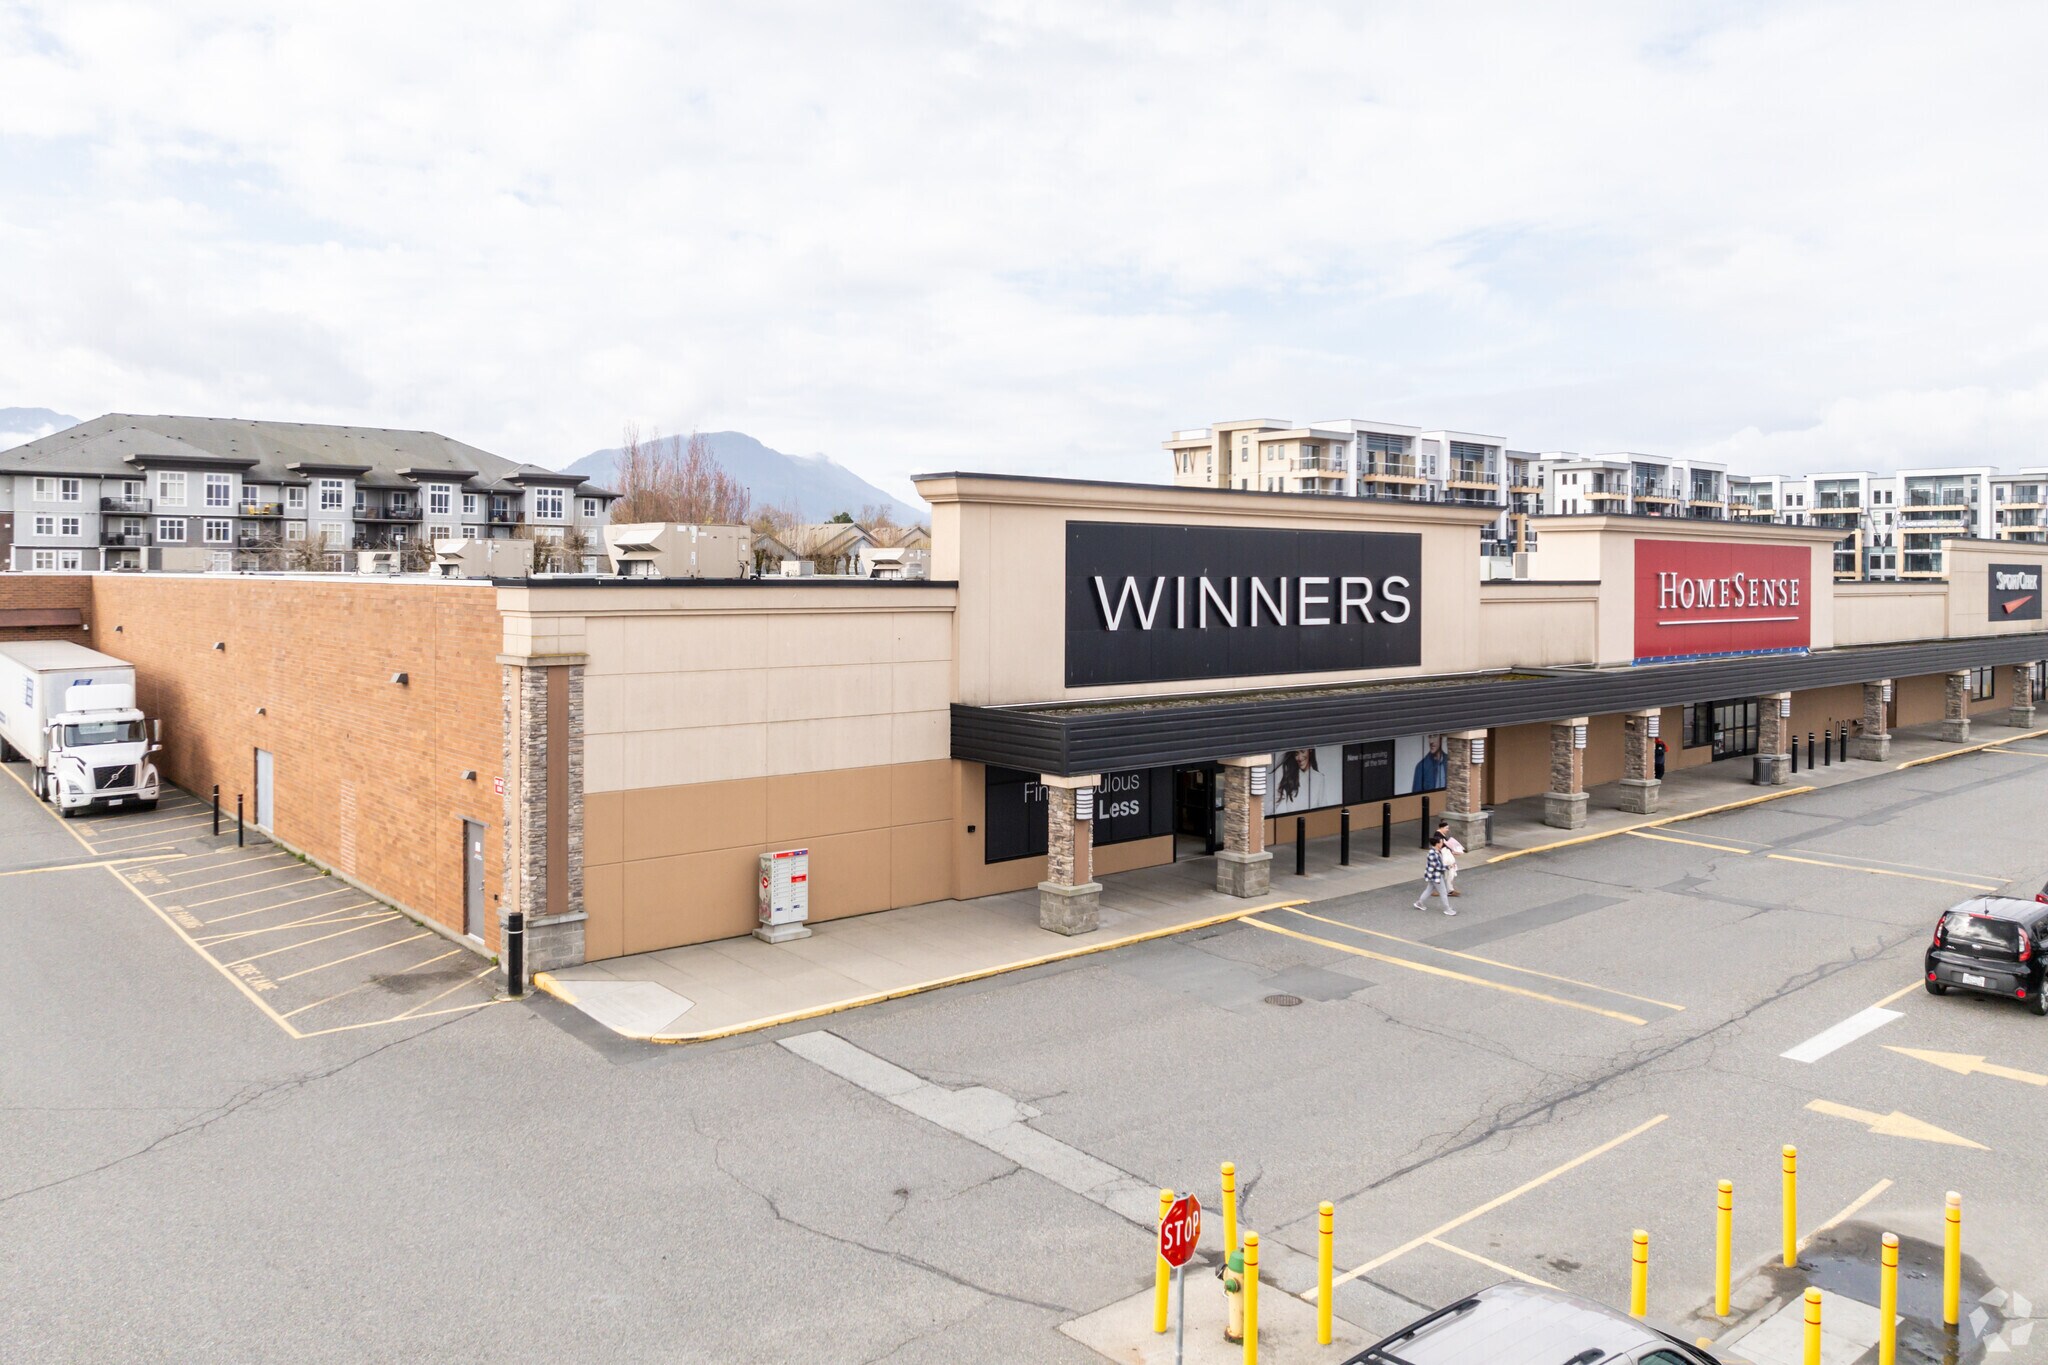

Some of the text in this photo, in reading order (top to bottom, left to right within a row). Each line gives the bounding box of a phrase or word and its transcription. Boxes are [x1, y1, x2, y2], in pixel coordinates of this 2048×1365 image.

[1094, 575, 1411, 631] WINNERS
[1024, 772, 1140, 803] Fin ulous
[1099, 799, 1140, 820] Less
[230, 963, 279, 992] FIRE LANE
[1163, 1210, 1199, 1250] STOP
